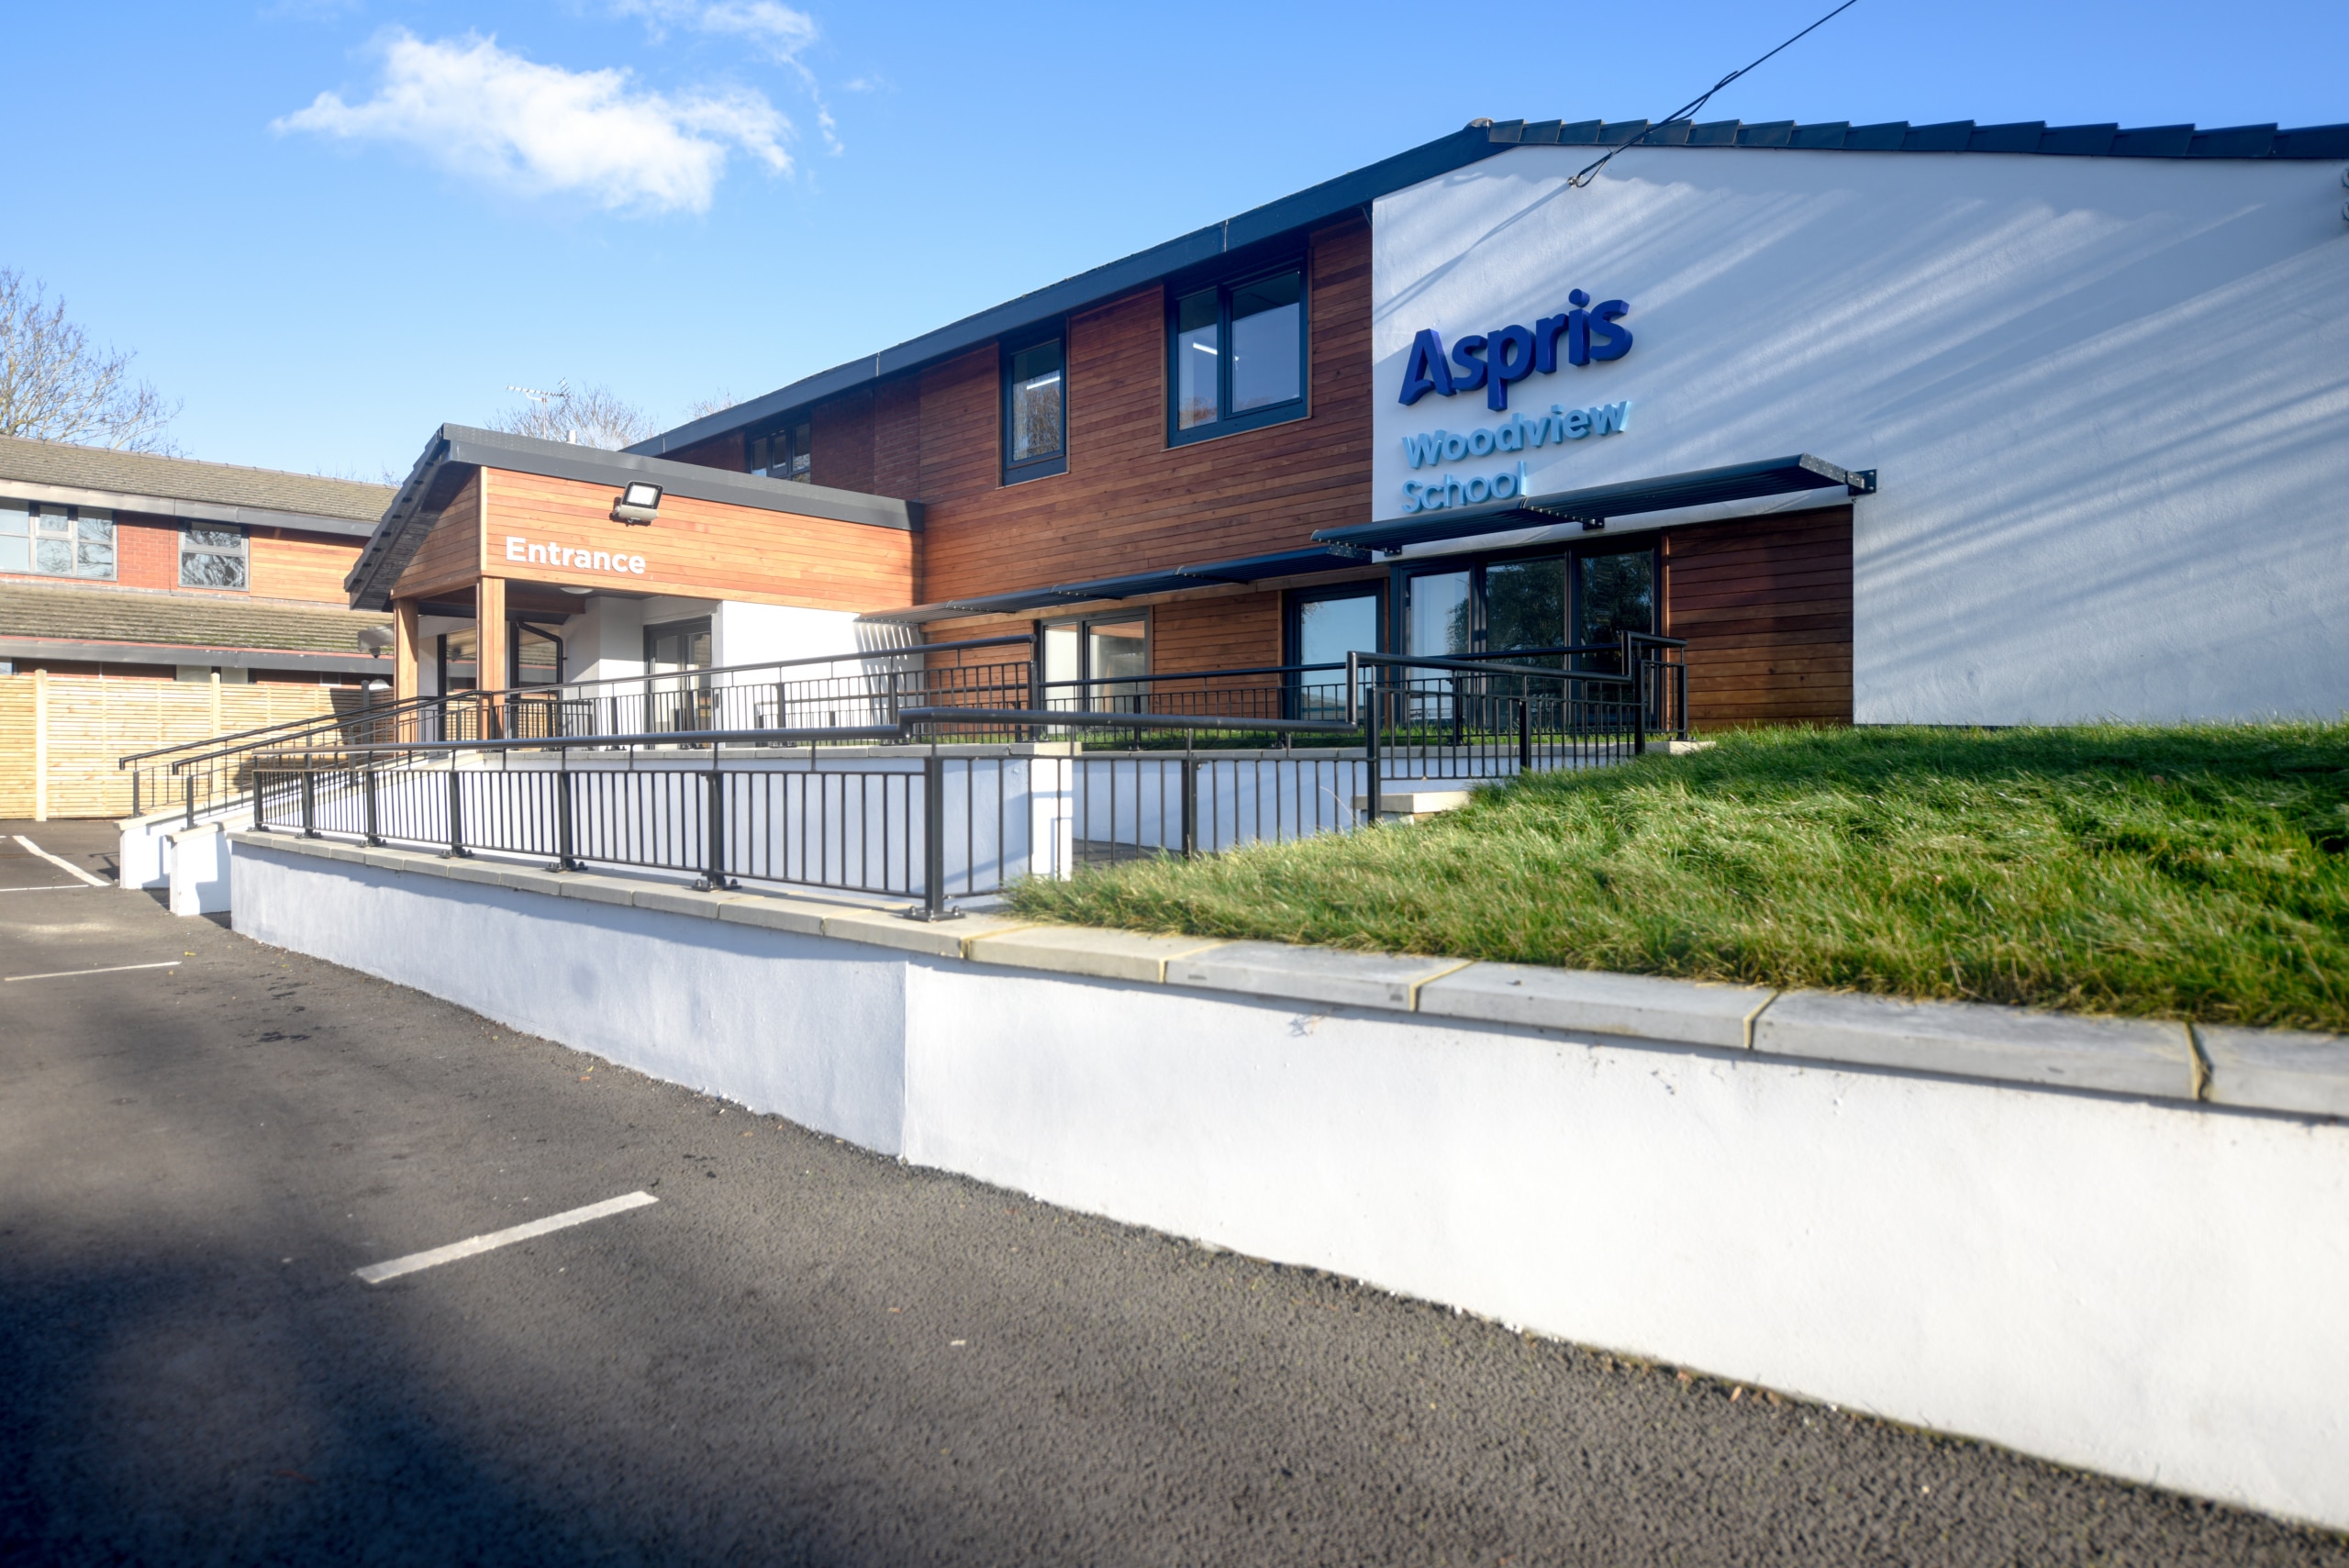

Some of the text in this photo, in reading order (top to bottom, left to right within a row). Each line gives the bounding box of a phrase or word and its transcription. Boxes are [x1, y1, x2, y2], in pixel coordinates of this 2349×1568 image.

[1398, 288, 1633, 412] Aspris
[1402, 401, 1631, 469] Woodview
[1402, 461, 1528, 513] School
[507, 536, 646, 574] Entrance
